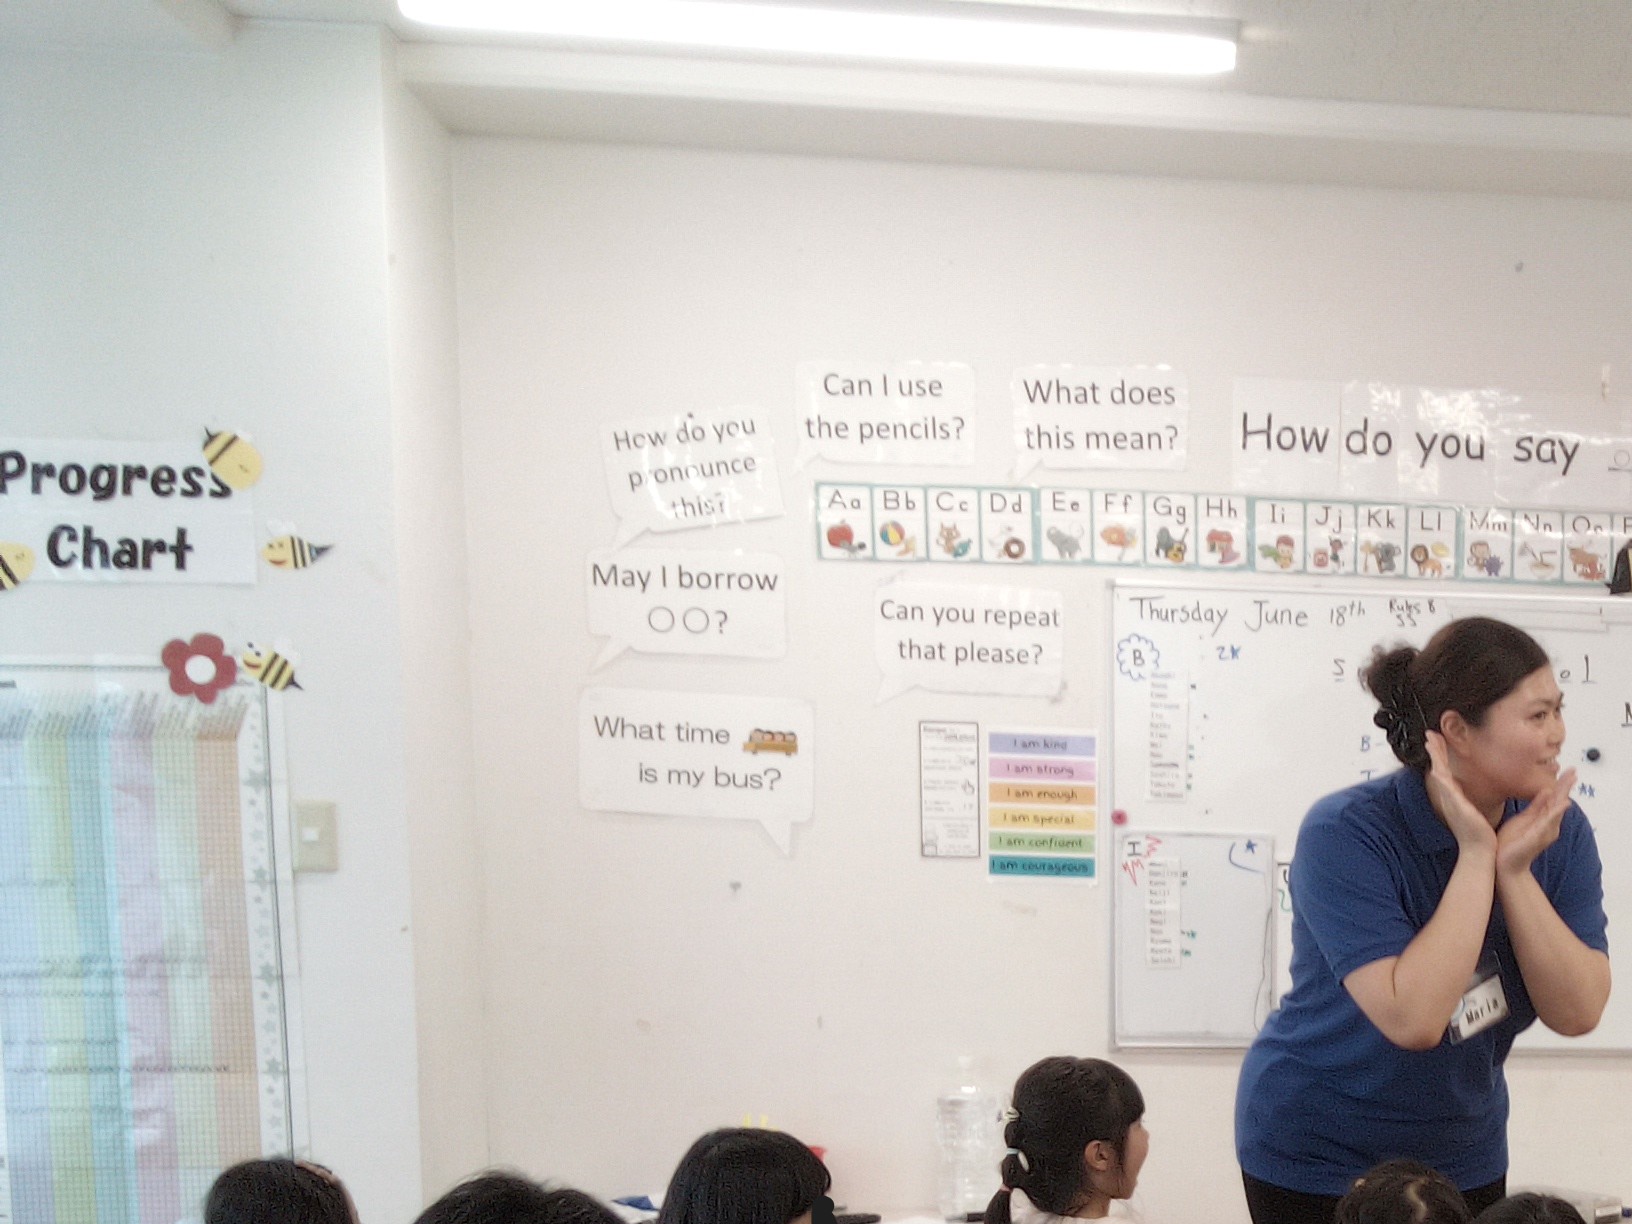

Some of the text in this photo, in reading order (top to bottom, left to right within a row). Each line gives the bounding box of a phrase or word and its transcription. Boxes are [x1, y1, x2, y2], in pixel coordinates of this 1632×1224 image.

[823, 373, 873, 397] Can
[898, 376, 943, 398] use
[1023, 379, 1176, 405] What does
[613, 418, 756, 451] How do you
[805, 415, 965, 444] the pencils?
[1025, 425, 1178, 451] this mean?
[1242, 411, 1330, 453] How
[1345, 417, 1393, 456] do
[1415, 432, 1485, 469] you
[1513, 435, 1581, 476] say
[828, 490, 862, 511] Aa
[884, 492, 917, 512] Bb
[990, 492, 1023, 514] Dd
[1053, 491, 1081, 513] Ee
[1104, 493, 1133, 513] Ff
[1153, 493, 1187, 524] Gg
[1206, 497, 1237, 518] Hh
[1315, 506, 1343, 534] Jj
[1367, 509, 1396, 530] Kk
[47, 524, 194, 570] Chart
[592, 564, 651, 594] May
[678, 564, 778, 591] borrow
[880, 599, 1060, 630] Can you repeat
[1130, 595, 1228, 637] Thursday
[1245, 600, 1308, 631] June
[898, 638, 1043, 666] that please?
[594, 715, 730, 744] What time
[1043, 739, 1067, 751] kind
[639, 763, 781, 790] is my bus?
[1036, 765, 1074, 777] strong
[1037, 789, 1078, 803] enough
